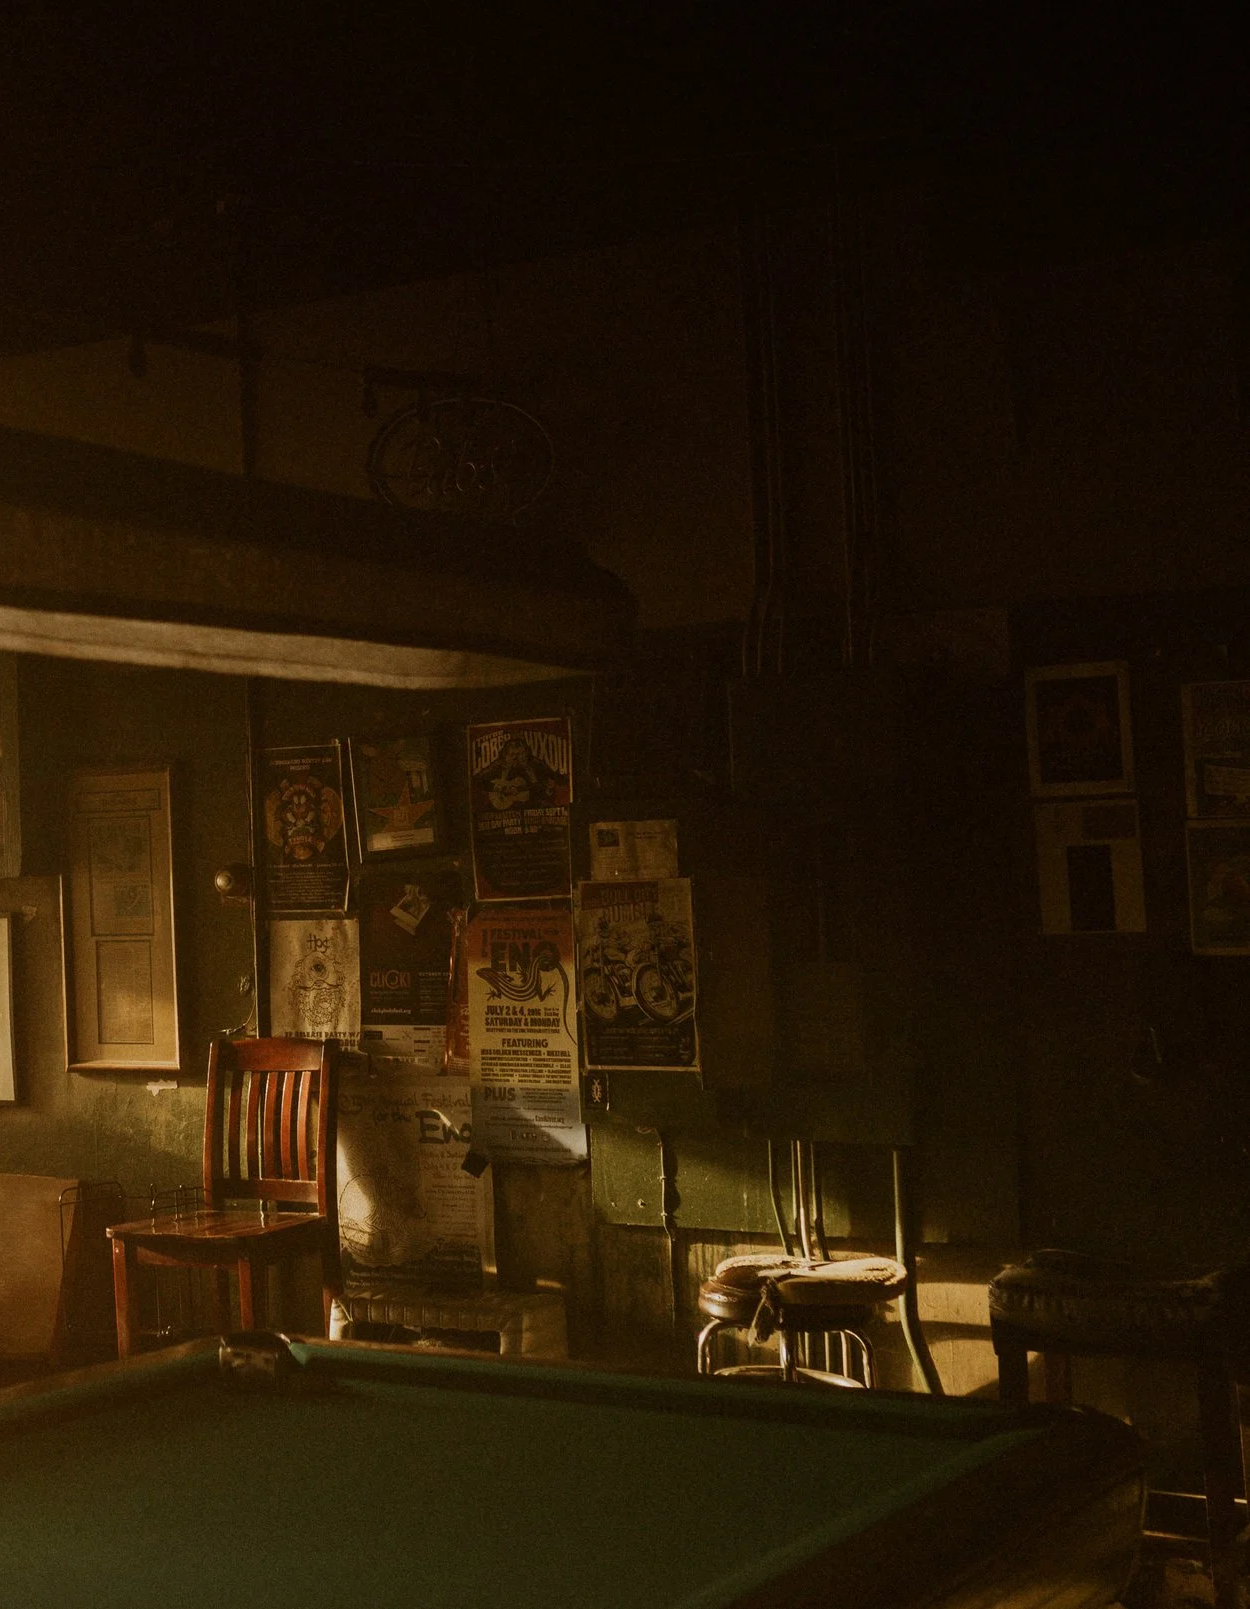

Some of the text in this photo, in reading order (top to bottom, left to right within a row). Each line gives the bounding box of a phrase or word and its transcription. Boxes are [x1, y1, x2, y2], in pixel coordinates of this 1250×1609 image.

[491, 928, 541, 940] FESTIVAL
[485, 1006, 505, 1016] JULY
[505, 1006, 511, 1016] 2
[512, 1006, 517, 1016] &
[485, 1017, 560, 1027] SATURDAY & MONDAY
[502, 1038, 548, 1048] FEATURING
[484, 1087, 516, 1101] PLUS
[415, 1110, 472, 1144] Eno
